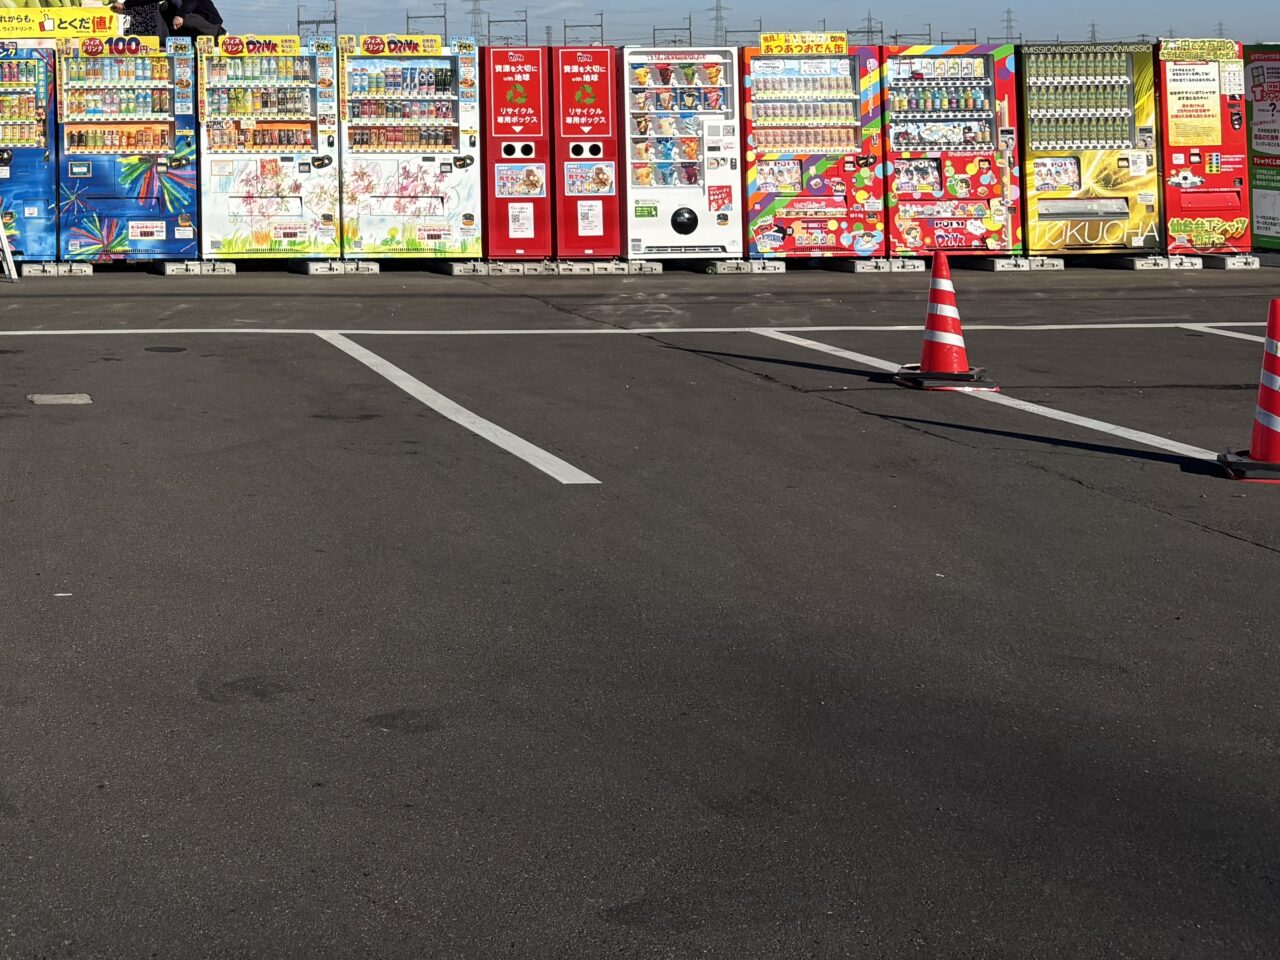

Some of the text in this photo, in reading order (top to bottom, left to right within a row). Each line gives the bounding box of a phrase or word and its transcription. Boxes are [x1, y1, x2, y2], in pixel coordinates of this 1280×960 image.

[57, 15, 114, 33] とくだ値!
[245, 40, 278, 54] DRINK
[386, 39, 420, 54] DRINK
[763, 44, 844, 54] あつあつおでん缶
[495, 64, 538, 73] 資源を大切に
[563, 65, 607, 73] 資源を大切に
[514, 73, 531, 82] 地球
[582, 74, 599, 82] 地球
[500, 107, 535, 115] リサイクル
[568, 108, 603, 116] リサイクル
[496, 116, 538, 124] 専用ボックス
[565, 116, 607, 124] 専用ボックス
[1169, 218, 1248, 234] 仙台弁Tシャツ
[1029, 220, 1160, 245] TOKUCHA
